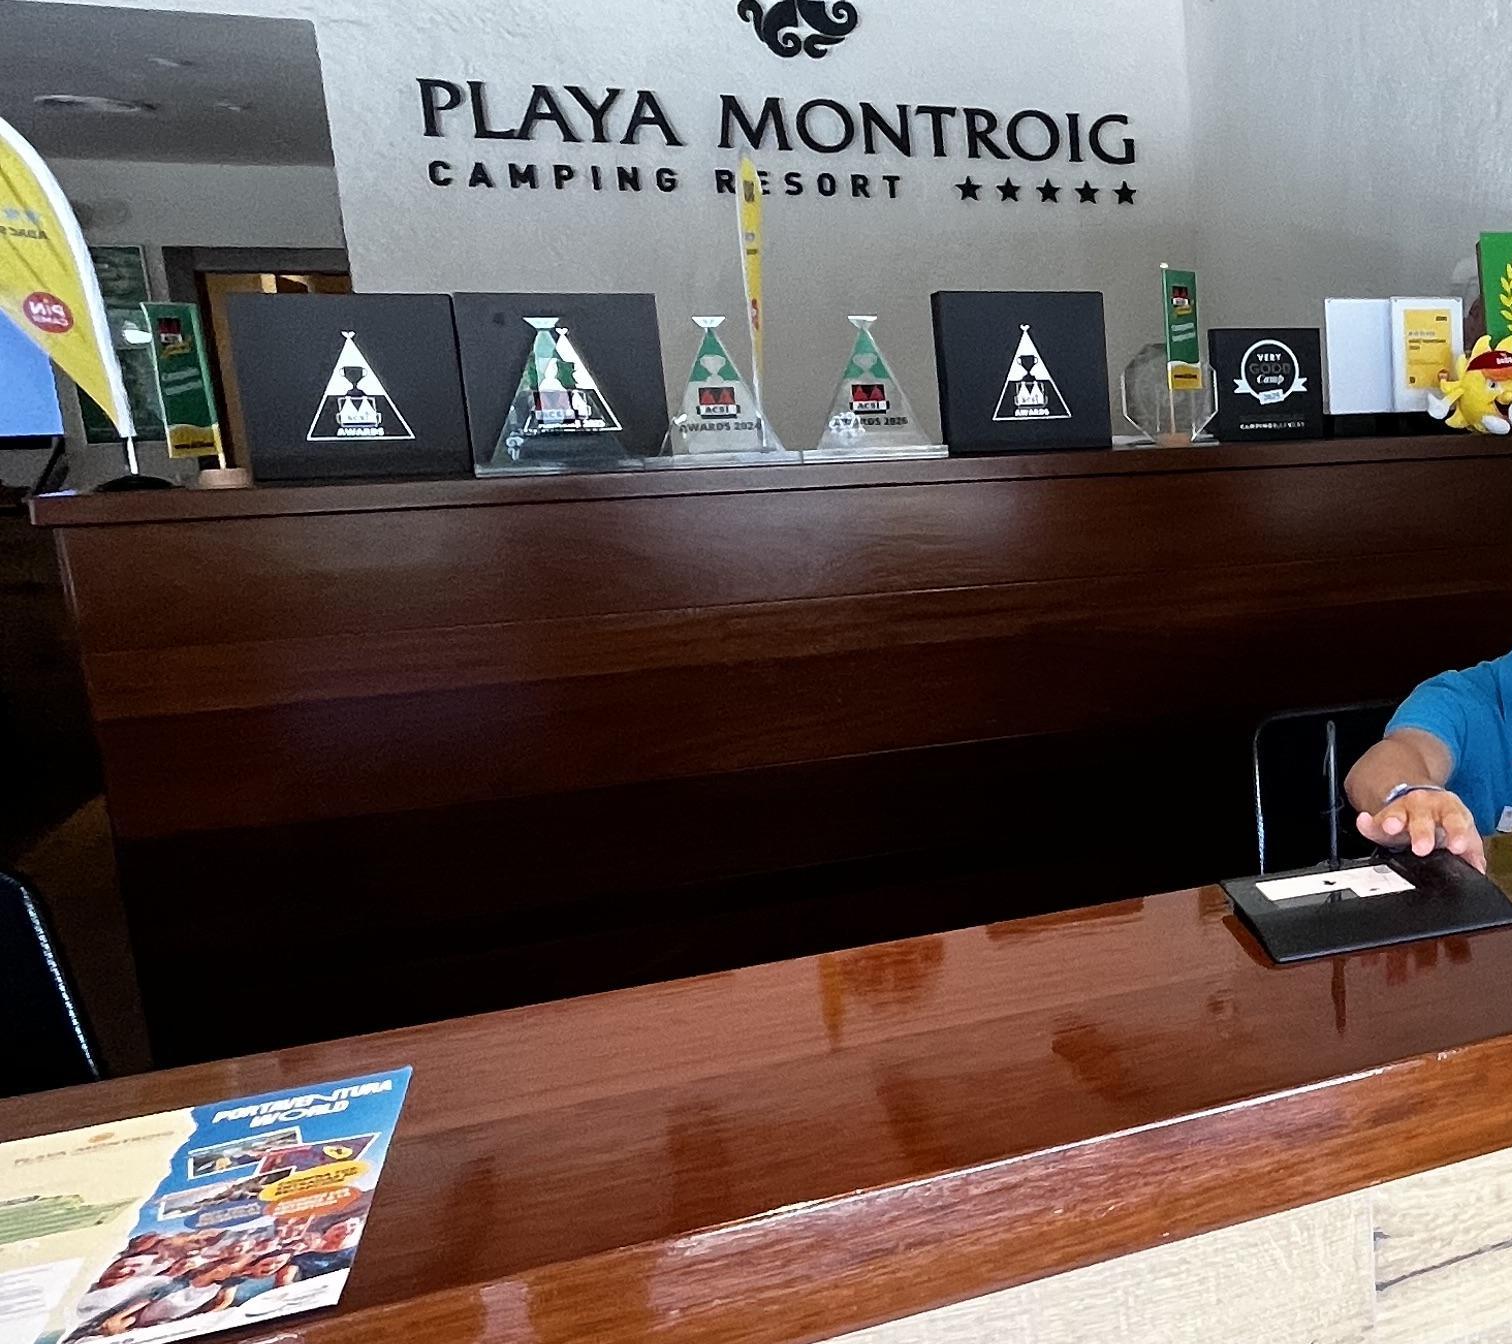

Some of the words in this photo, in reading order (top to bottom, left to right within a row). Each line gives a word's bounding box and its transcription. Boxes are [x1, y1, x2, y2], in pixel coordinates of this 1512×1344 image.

[416, 77, 687, 147] PLAYA
[717, 94, 1137, 165] MONTROIG
[428, 160, 679, 193] CAMPING
[714, 168, 901, 200] RESORT
[1257, 353, 1281, 362] VERY
[1249, 362, 1291, 374] GOOD
[1256, 374, 1285, 385] Camp
[705, 406, 730, 414] ACSI
[857, 401, 880, 410] ACSI
[1014, 408, 1050, 417] AWARDS
[336, 427, 385, 437] AWARDS
[212, 1079, 393, 1124] PORTAVENTURA
[249, 1100, 350, 1129] WORLD
